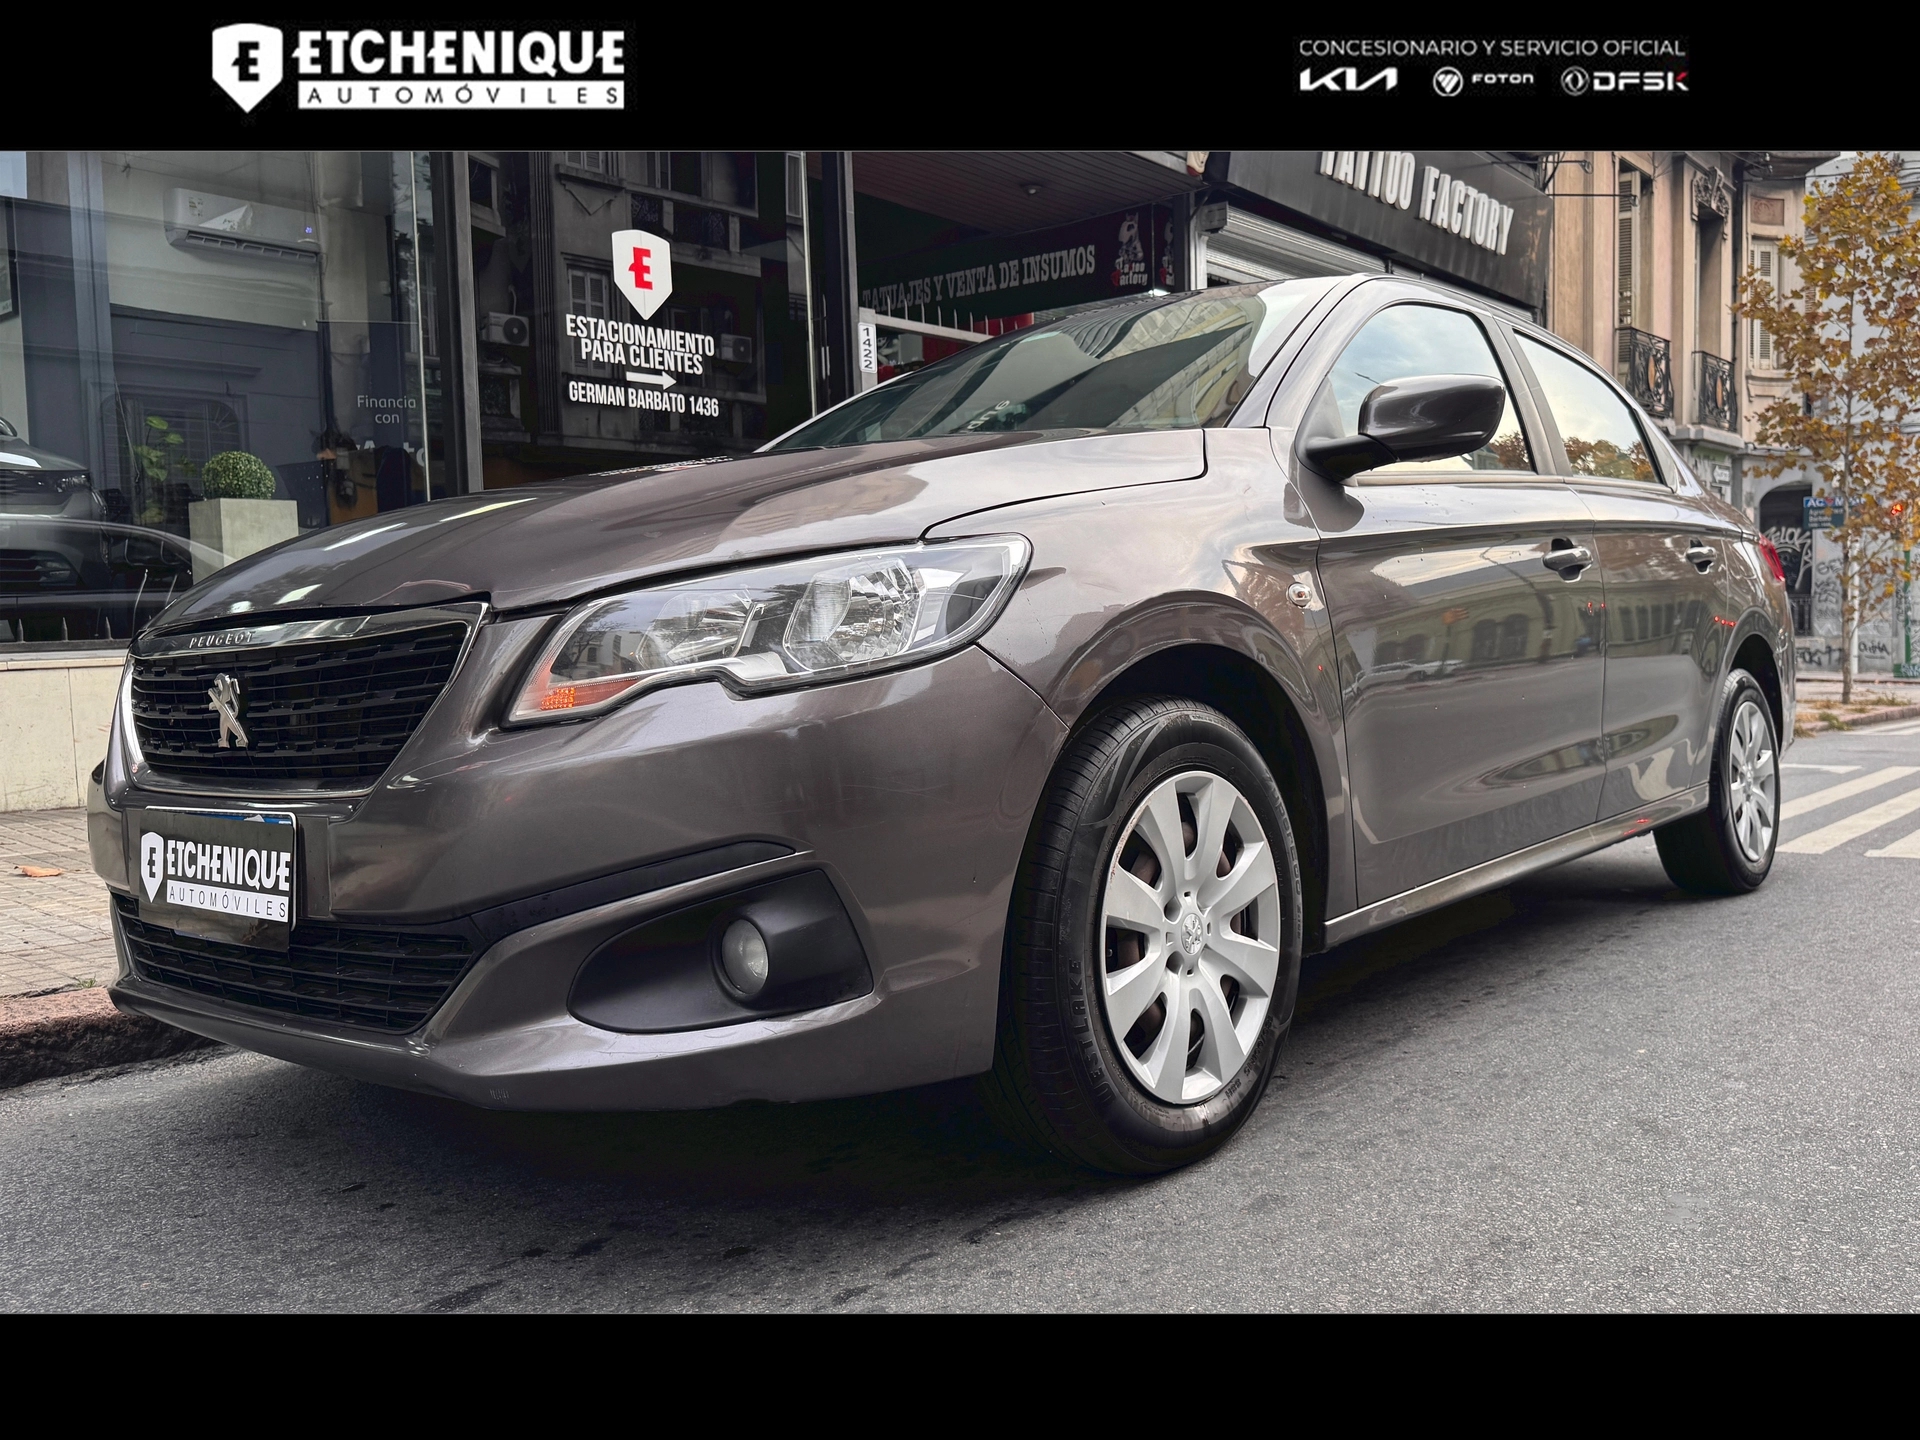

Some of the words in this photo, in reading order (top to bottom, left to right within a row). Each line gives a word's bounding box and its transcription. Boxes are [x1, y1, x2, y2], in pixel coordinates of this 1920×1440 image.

[1419, 165, 1514, 256] FACTORY
[861, 277, 932, 313] TATUAJES
[933, 274, 944, 301] Y
[946, 263, 997, 299] VENTA
[999, 259, 1020, 290] DE
[1022, 244, 1096, 286] INSUMOS
[565, 313, 715, 357] ESTACIONAMIENTO
[862, 327, 873, 370] 1422
[580, 338, 626, 366] PARA
[629, 344, 704, 375] CLIENTES
[357, 395, 417, 408] Financia
[568, 380, 626, 407] GERMAN
[628, 387, 686, 414] BARBATO
[689, 395, 720, 418] 1436
[375, 413, 400, 424] con
[189, 630, 257, 649] PEUGEOT
[166, 839, 291, 892] ETCHENIQUE
[169, 885, 287, 918] AUTOMÓVILES
